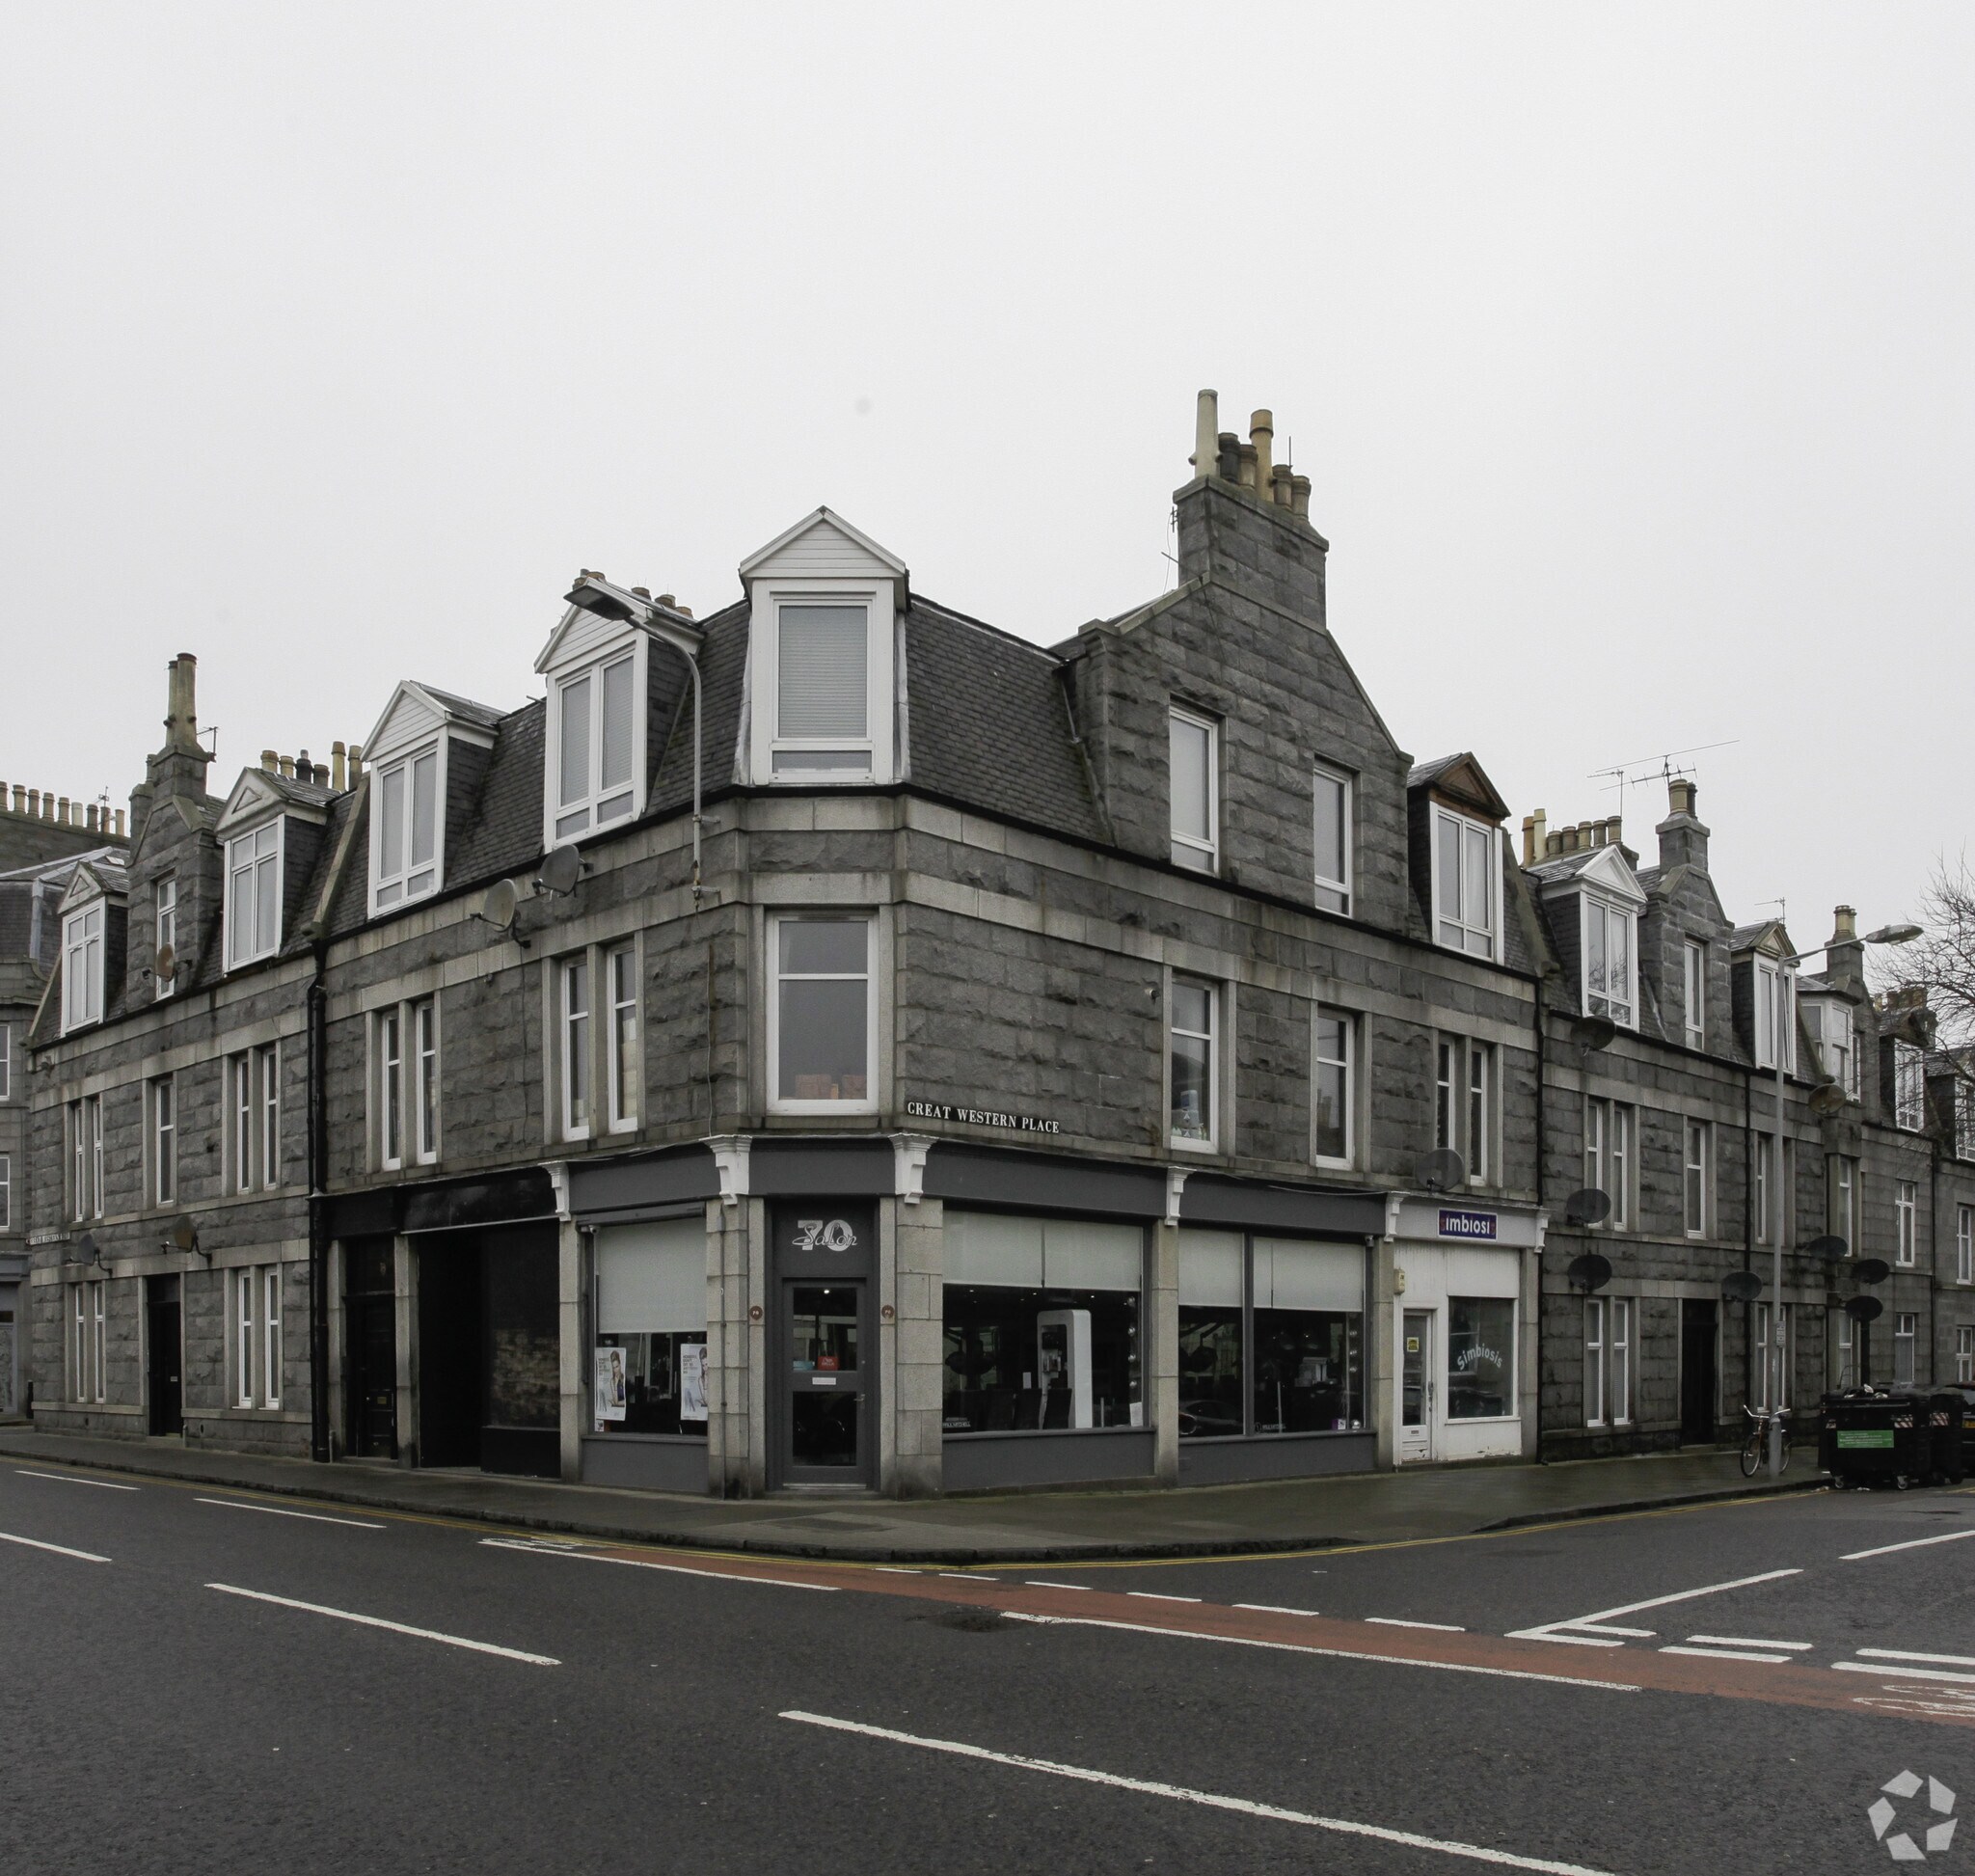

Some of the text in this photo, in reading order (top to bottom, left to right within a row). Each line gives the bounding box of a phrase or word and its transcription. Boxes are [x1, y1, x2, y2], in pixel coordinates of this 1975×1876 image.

[907, 1101, 1060, 1133] GREAT WESTERN PLACE
[798, 1219, 853, 1252] 70
[1457, 1343, 1503, 1371] Simbiosis
